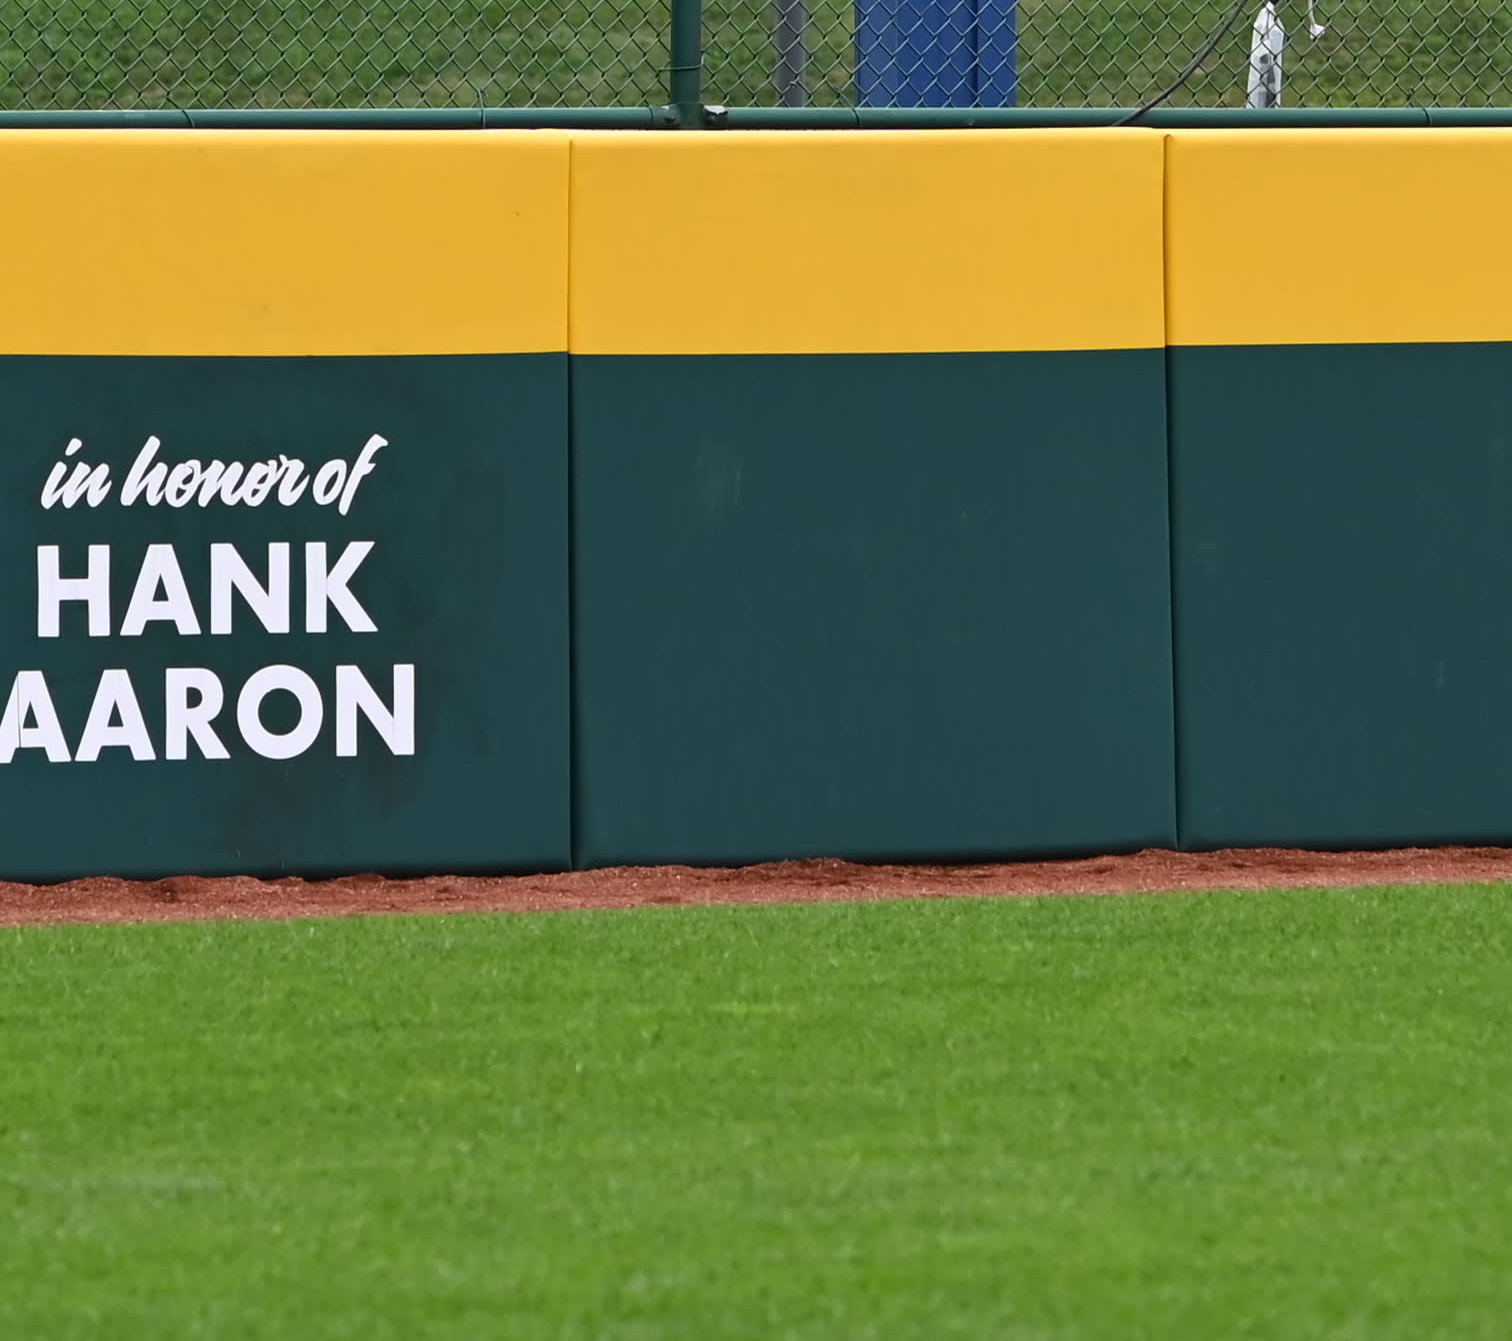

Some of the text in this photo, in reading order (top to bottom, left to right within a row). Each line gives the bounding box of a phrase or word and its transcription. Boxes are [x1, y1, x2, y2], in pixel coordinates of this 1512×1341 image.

[41, 433, 389, 516] in honor of
[38, 542, 378, 637] HANK
